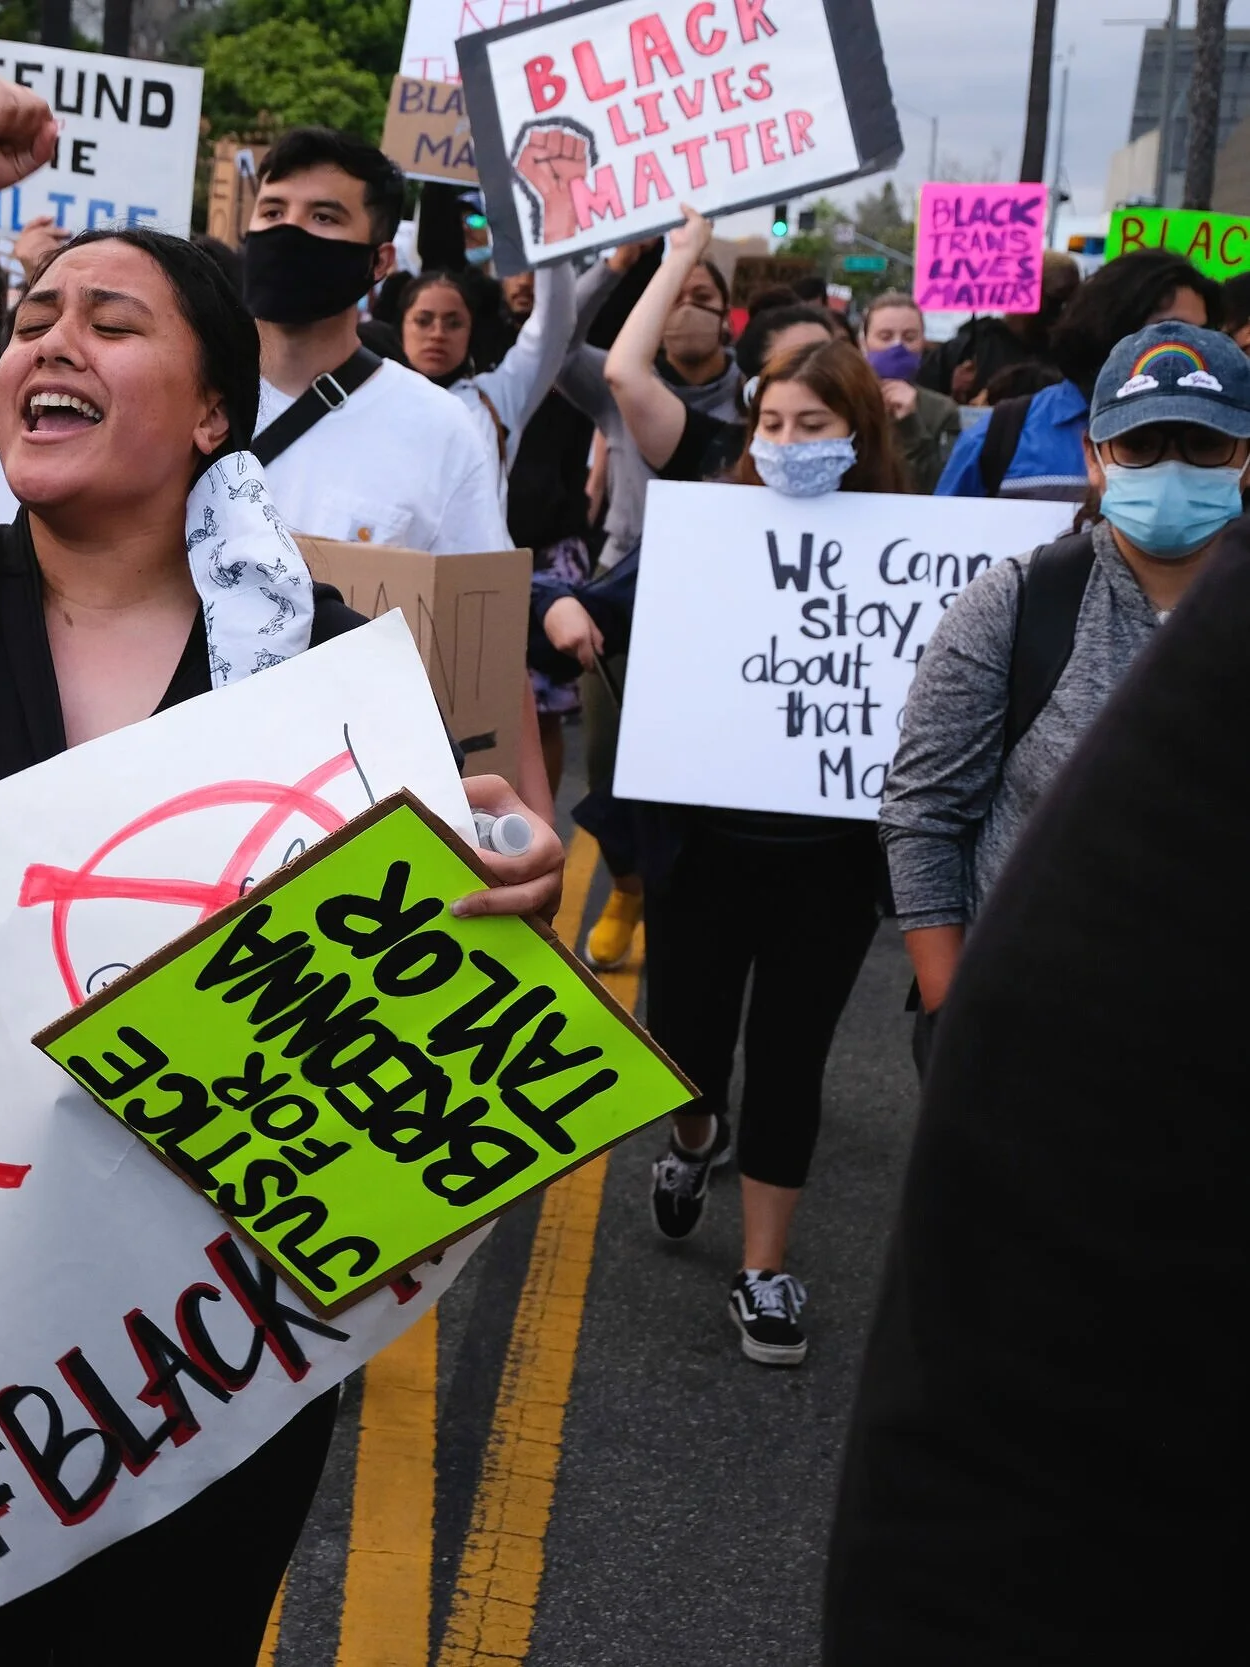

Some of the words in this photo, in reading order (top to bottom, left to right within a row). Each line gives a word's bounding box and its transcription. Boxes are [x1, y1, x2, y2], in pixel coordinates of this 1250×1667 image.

[524, 0, 778, 113] BLACK
[608, 64, 773, 146] LIVES
[570, 110, 814, 231] MATTER
[929, 229, 1032, 257] TRANS
[933, 196, 1041, 229] BLACK
[928, 256, 1035, 280] LIVES
[766, 530, 846, 592] We
[800, 593, 922, 658] stay
[741, 636, 872, 691] about
[777, 687, 881, 738] that
[314, 859, 620, 1155] TAYLOR
[193, 903, 540, 1207] BREONNA
[212, 1050, 354, 1177] FOR
[66, 1026, 381, 1293] JUSTICE
